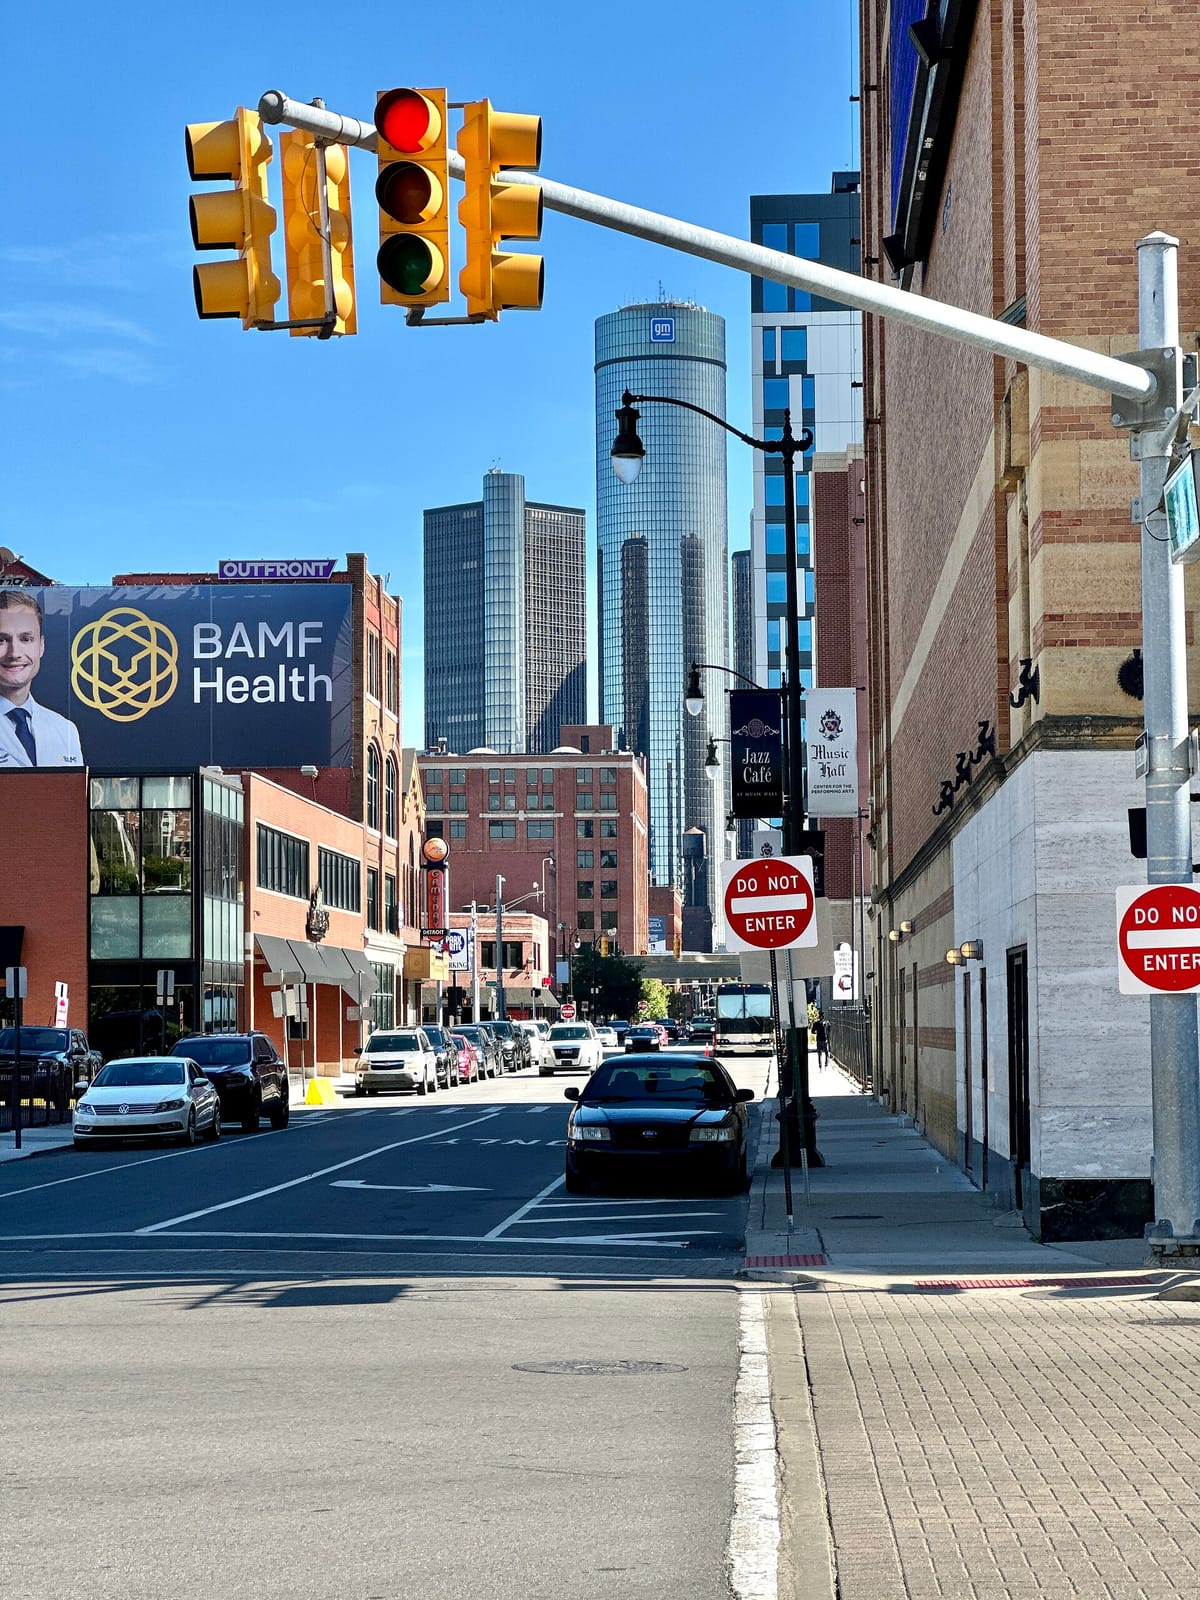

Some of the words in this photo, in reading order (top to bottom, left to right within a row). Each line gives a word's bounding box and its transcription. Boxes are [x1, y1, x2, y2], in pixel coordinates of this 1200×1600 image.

[655, 323, 671, 336] gm
[223, 562, 329, 577] OUTFRONT
[193, 621, 323, 659] BAMF
[193, 664, 333, 704] Health
[742, 748, 770, 765] Jazz
[811, 744, 849, 761] Music
[743, 766, 772, 783] Café
[818, 762, 846, 778] Hall
[737, 878, 758, 893] DO
[768, 875, 799, 891] NOT
[1134, 907, 1159, 924] DO
[1172, 905, 1200, 923] NO
[745, 915, 796, 932] ENTER
[449, 961, 467, 969] RKING
[1143, 953, 1200, 971] ENTER
